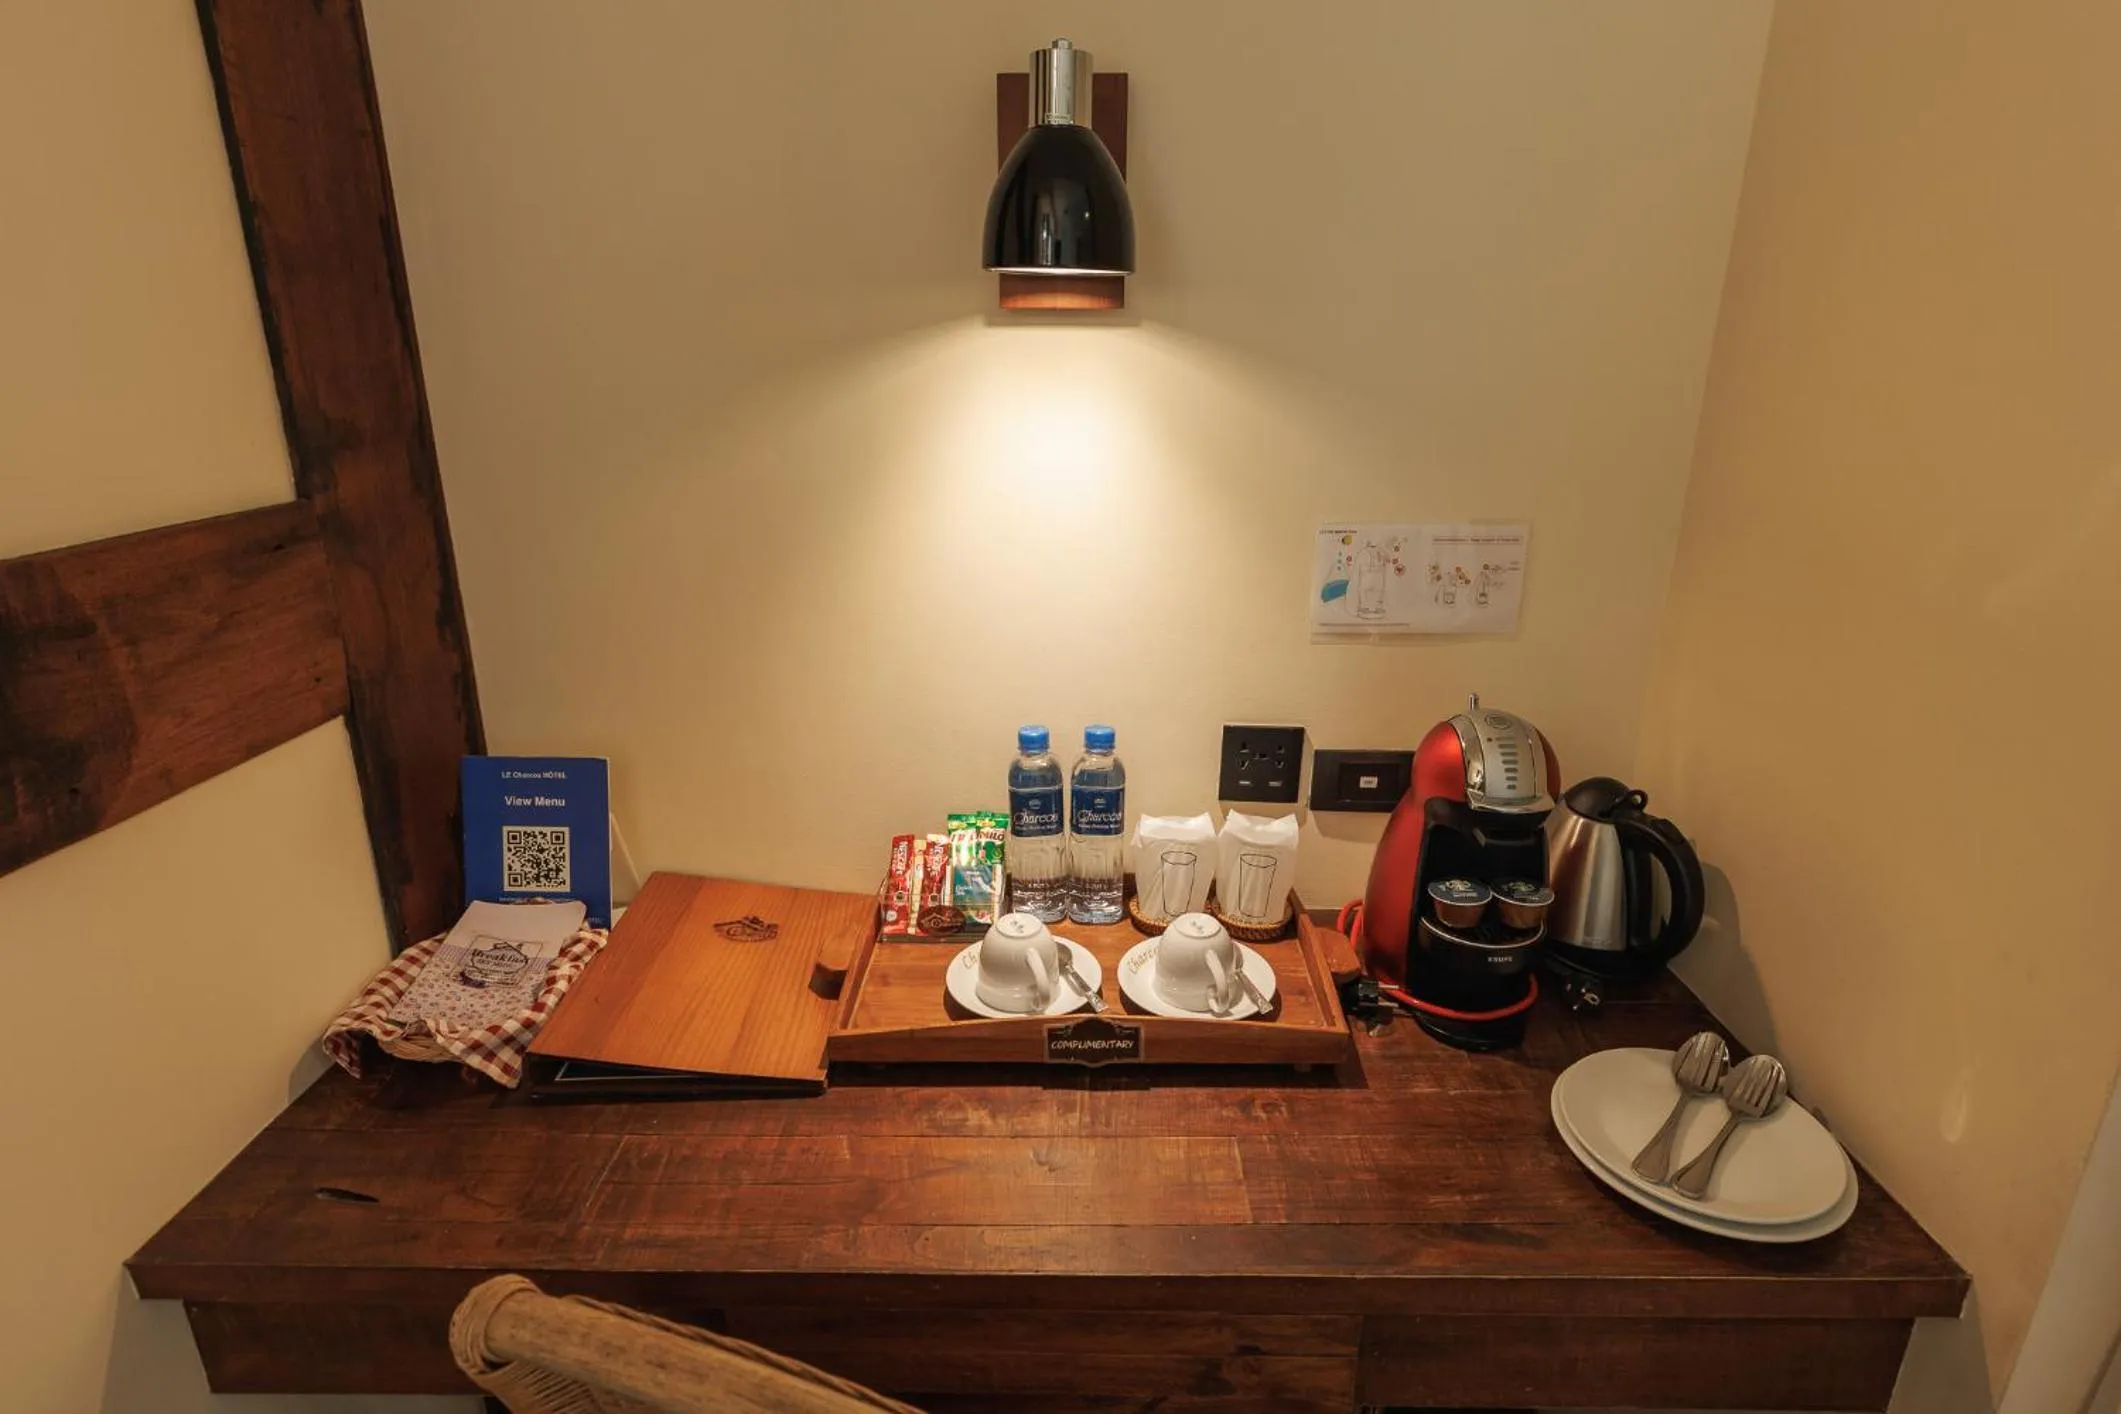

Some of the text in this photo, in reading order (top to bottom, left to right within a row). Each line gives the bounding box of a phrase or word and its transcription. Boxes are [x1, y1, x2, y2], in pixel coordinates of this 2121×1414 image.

[504, 795, 566, 807] View Menu
[1051, 1040, 1135, 1050] COMPLIMENTARY
